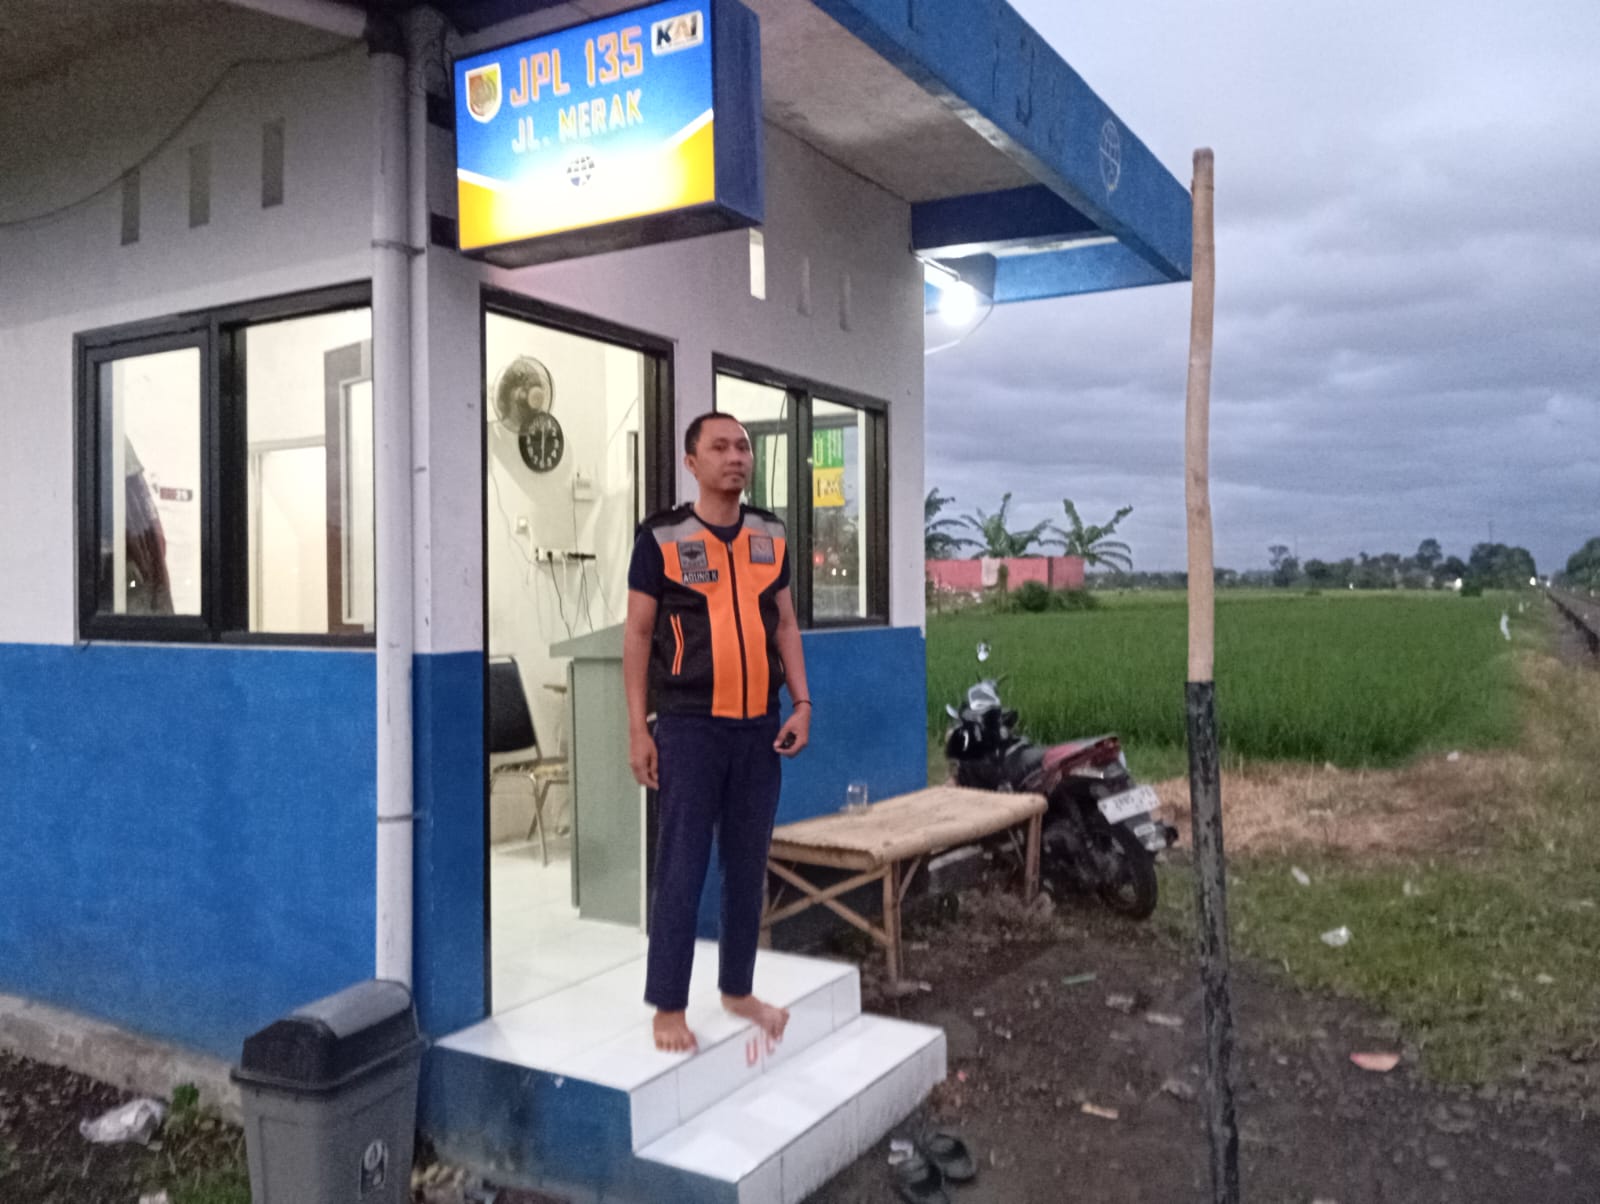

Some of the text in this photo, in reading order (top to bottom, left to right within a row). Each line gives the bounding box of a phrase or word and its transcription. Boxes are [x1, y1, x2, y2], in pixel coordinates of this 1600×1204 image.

[656, 14, 698, 46] KAI
[510, 25, 643, 107] JPL 135
[511, 88, 644, 154] JL. MERAK
